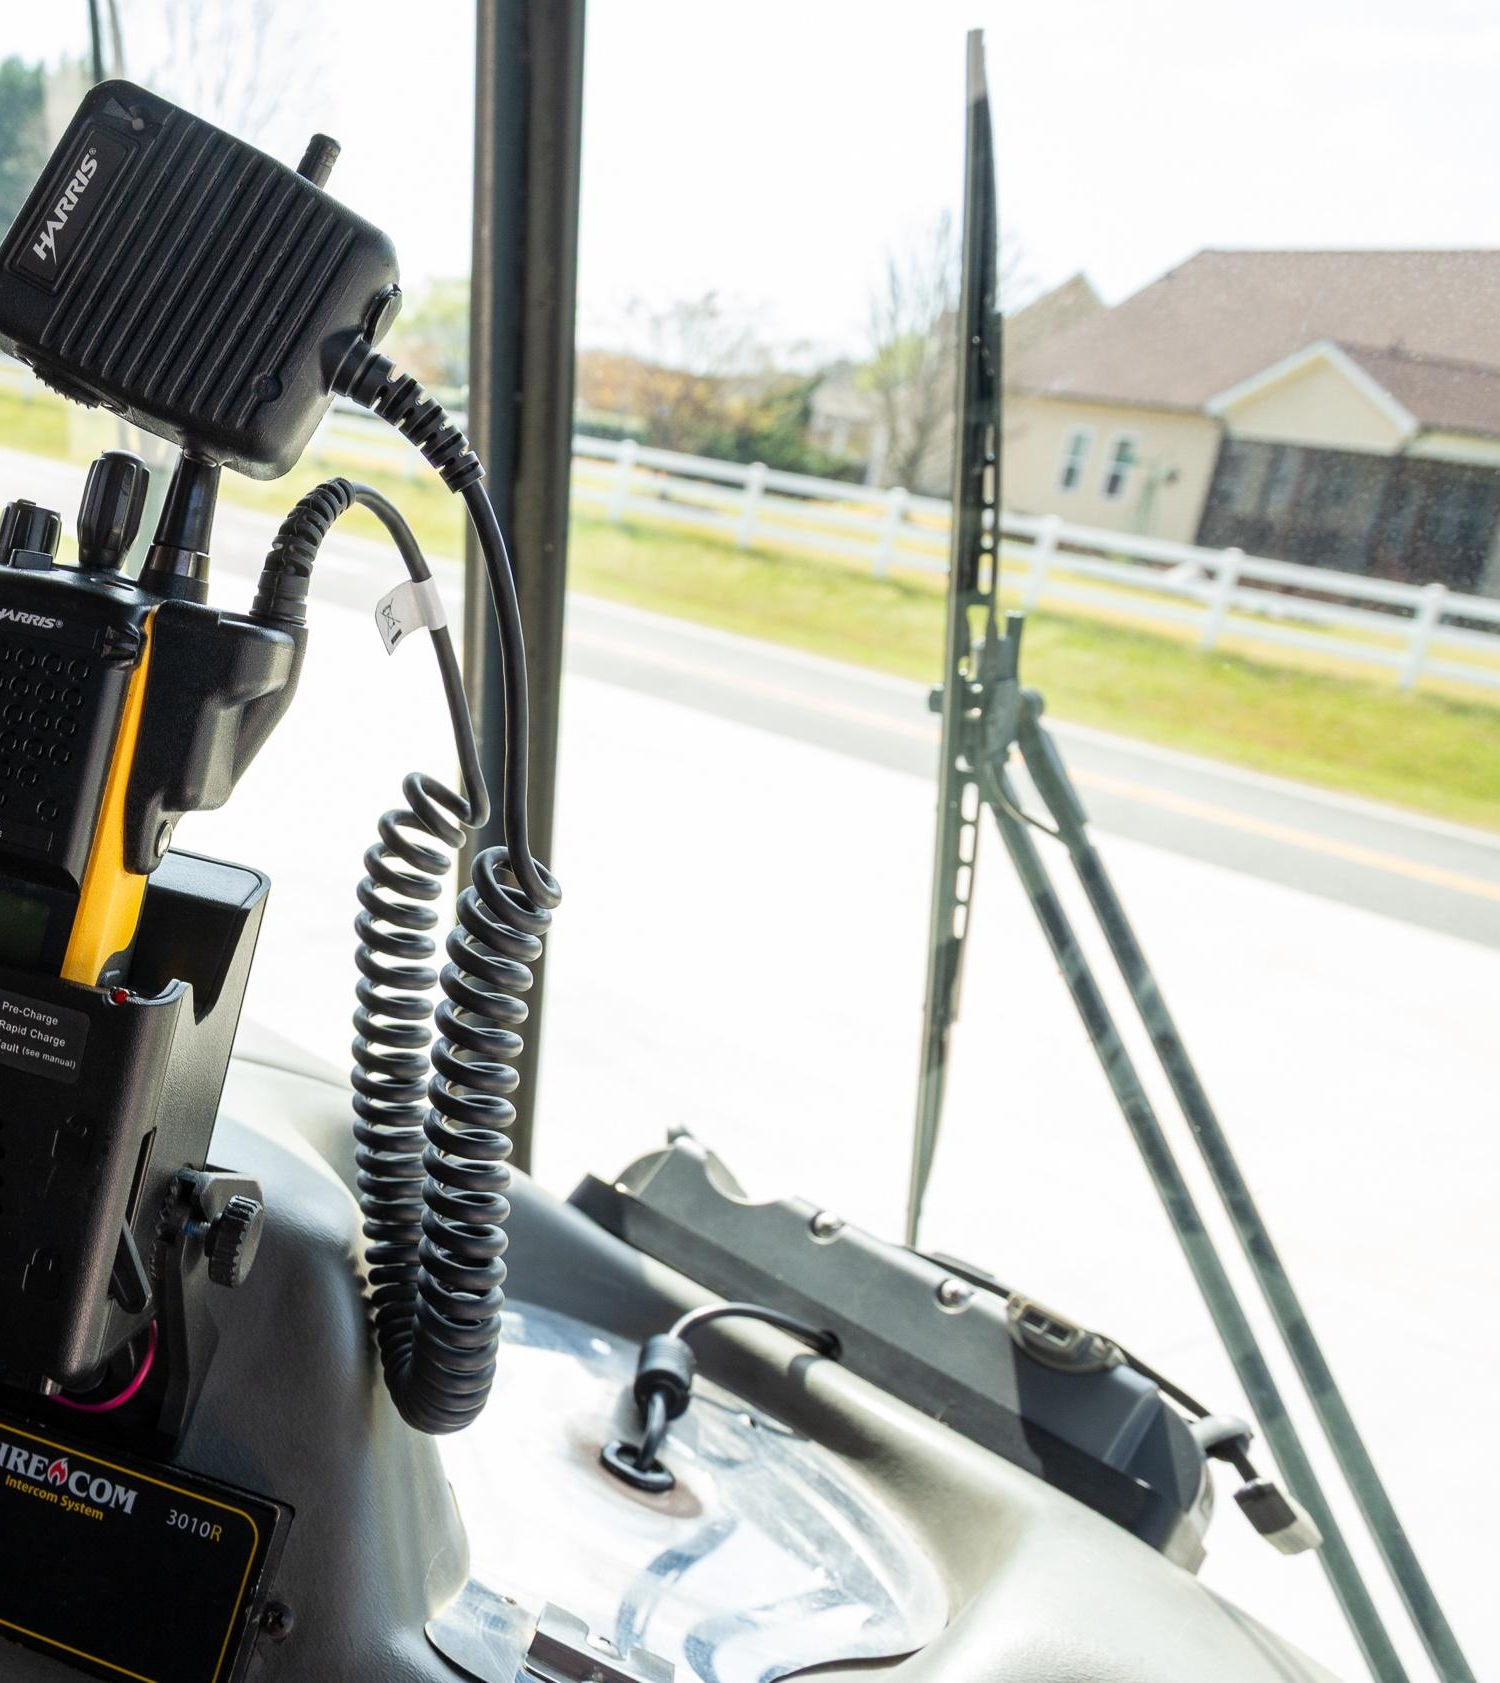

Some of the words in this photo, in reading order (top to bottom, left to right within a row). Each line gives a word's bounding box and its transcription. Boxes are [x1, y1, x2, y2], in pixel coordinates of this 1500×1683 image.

[1, 1000, 59, 1026] Pre-Charge
[30, 1028, 66, 1047] Charge
[22, 1046, 40, 1059] (see
[42, 1052, 77, 1070] manual)
[4, 1474, 58, 1504] Intercom
[59, 1495, 104, 1521] System
[165, 1508, 223, 1543] 3010R
